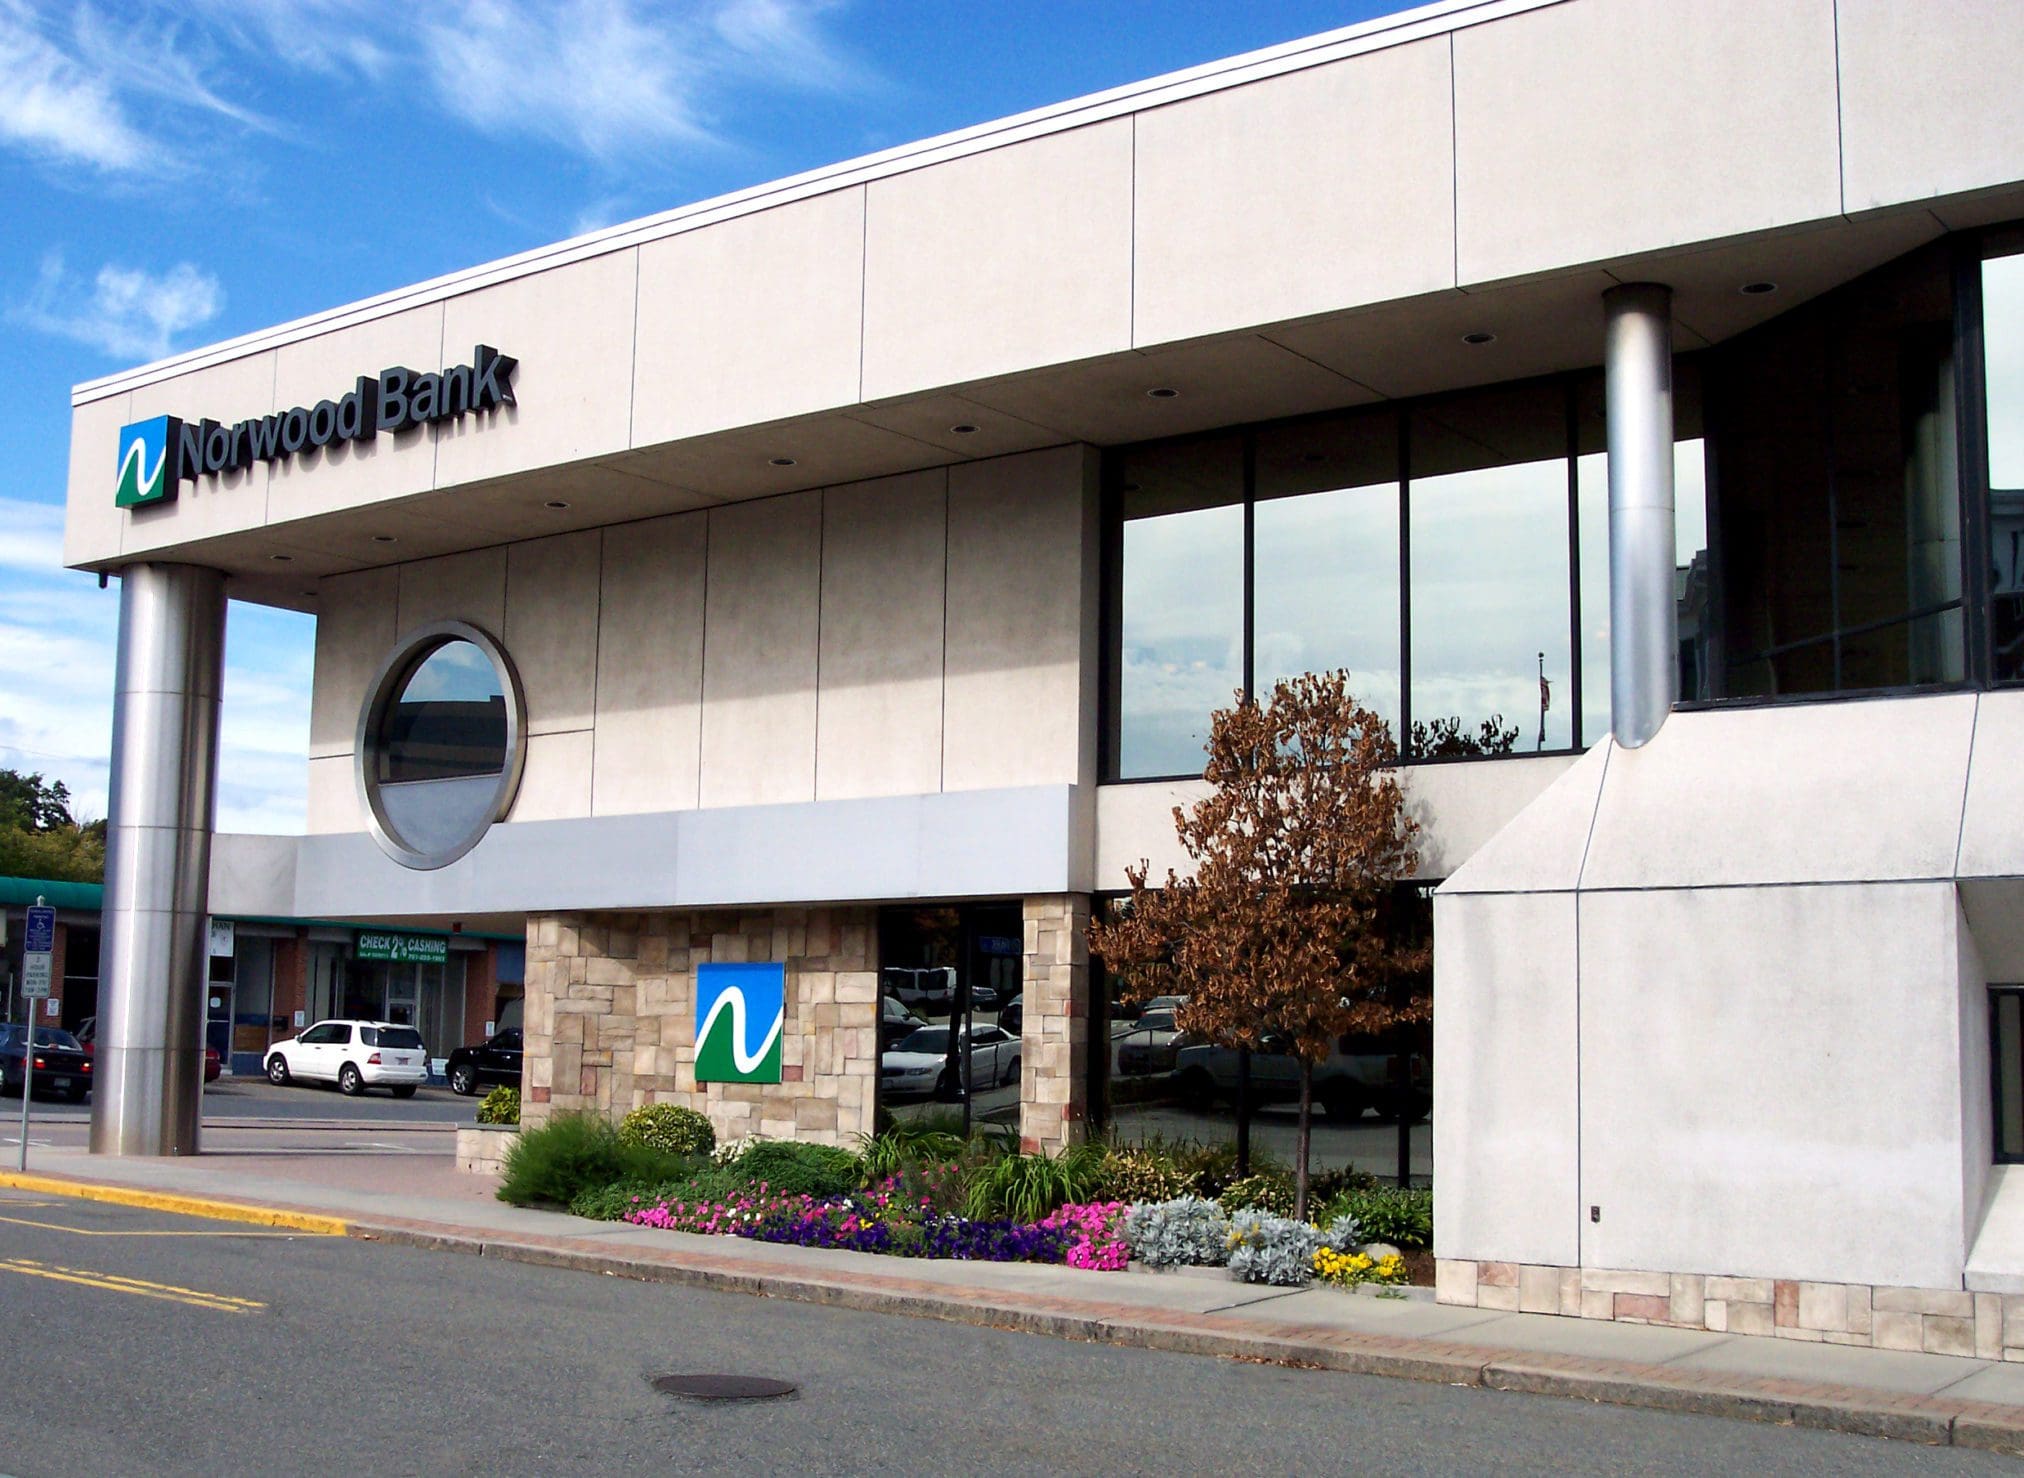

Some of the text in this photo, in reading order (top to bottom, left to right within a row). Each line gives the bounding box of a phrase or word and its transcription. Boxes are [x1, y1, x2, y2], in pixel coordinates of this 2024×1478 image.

[177, 343, 519, 480] Norwood Bank
[360, 934, 446, 960] CHECK 2% CASHING
